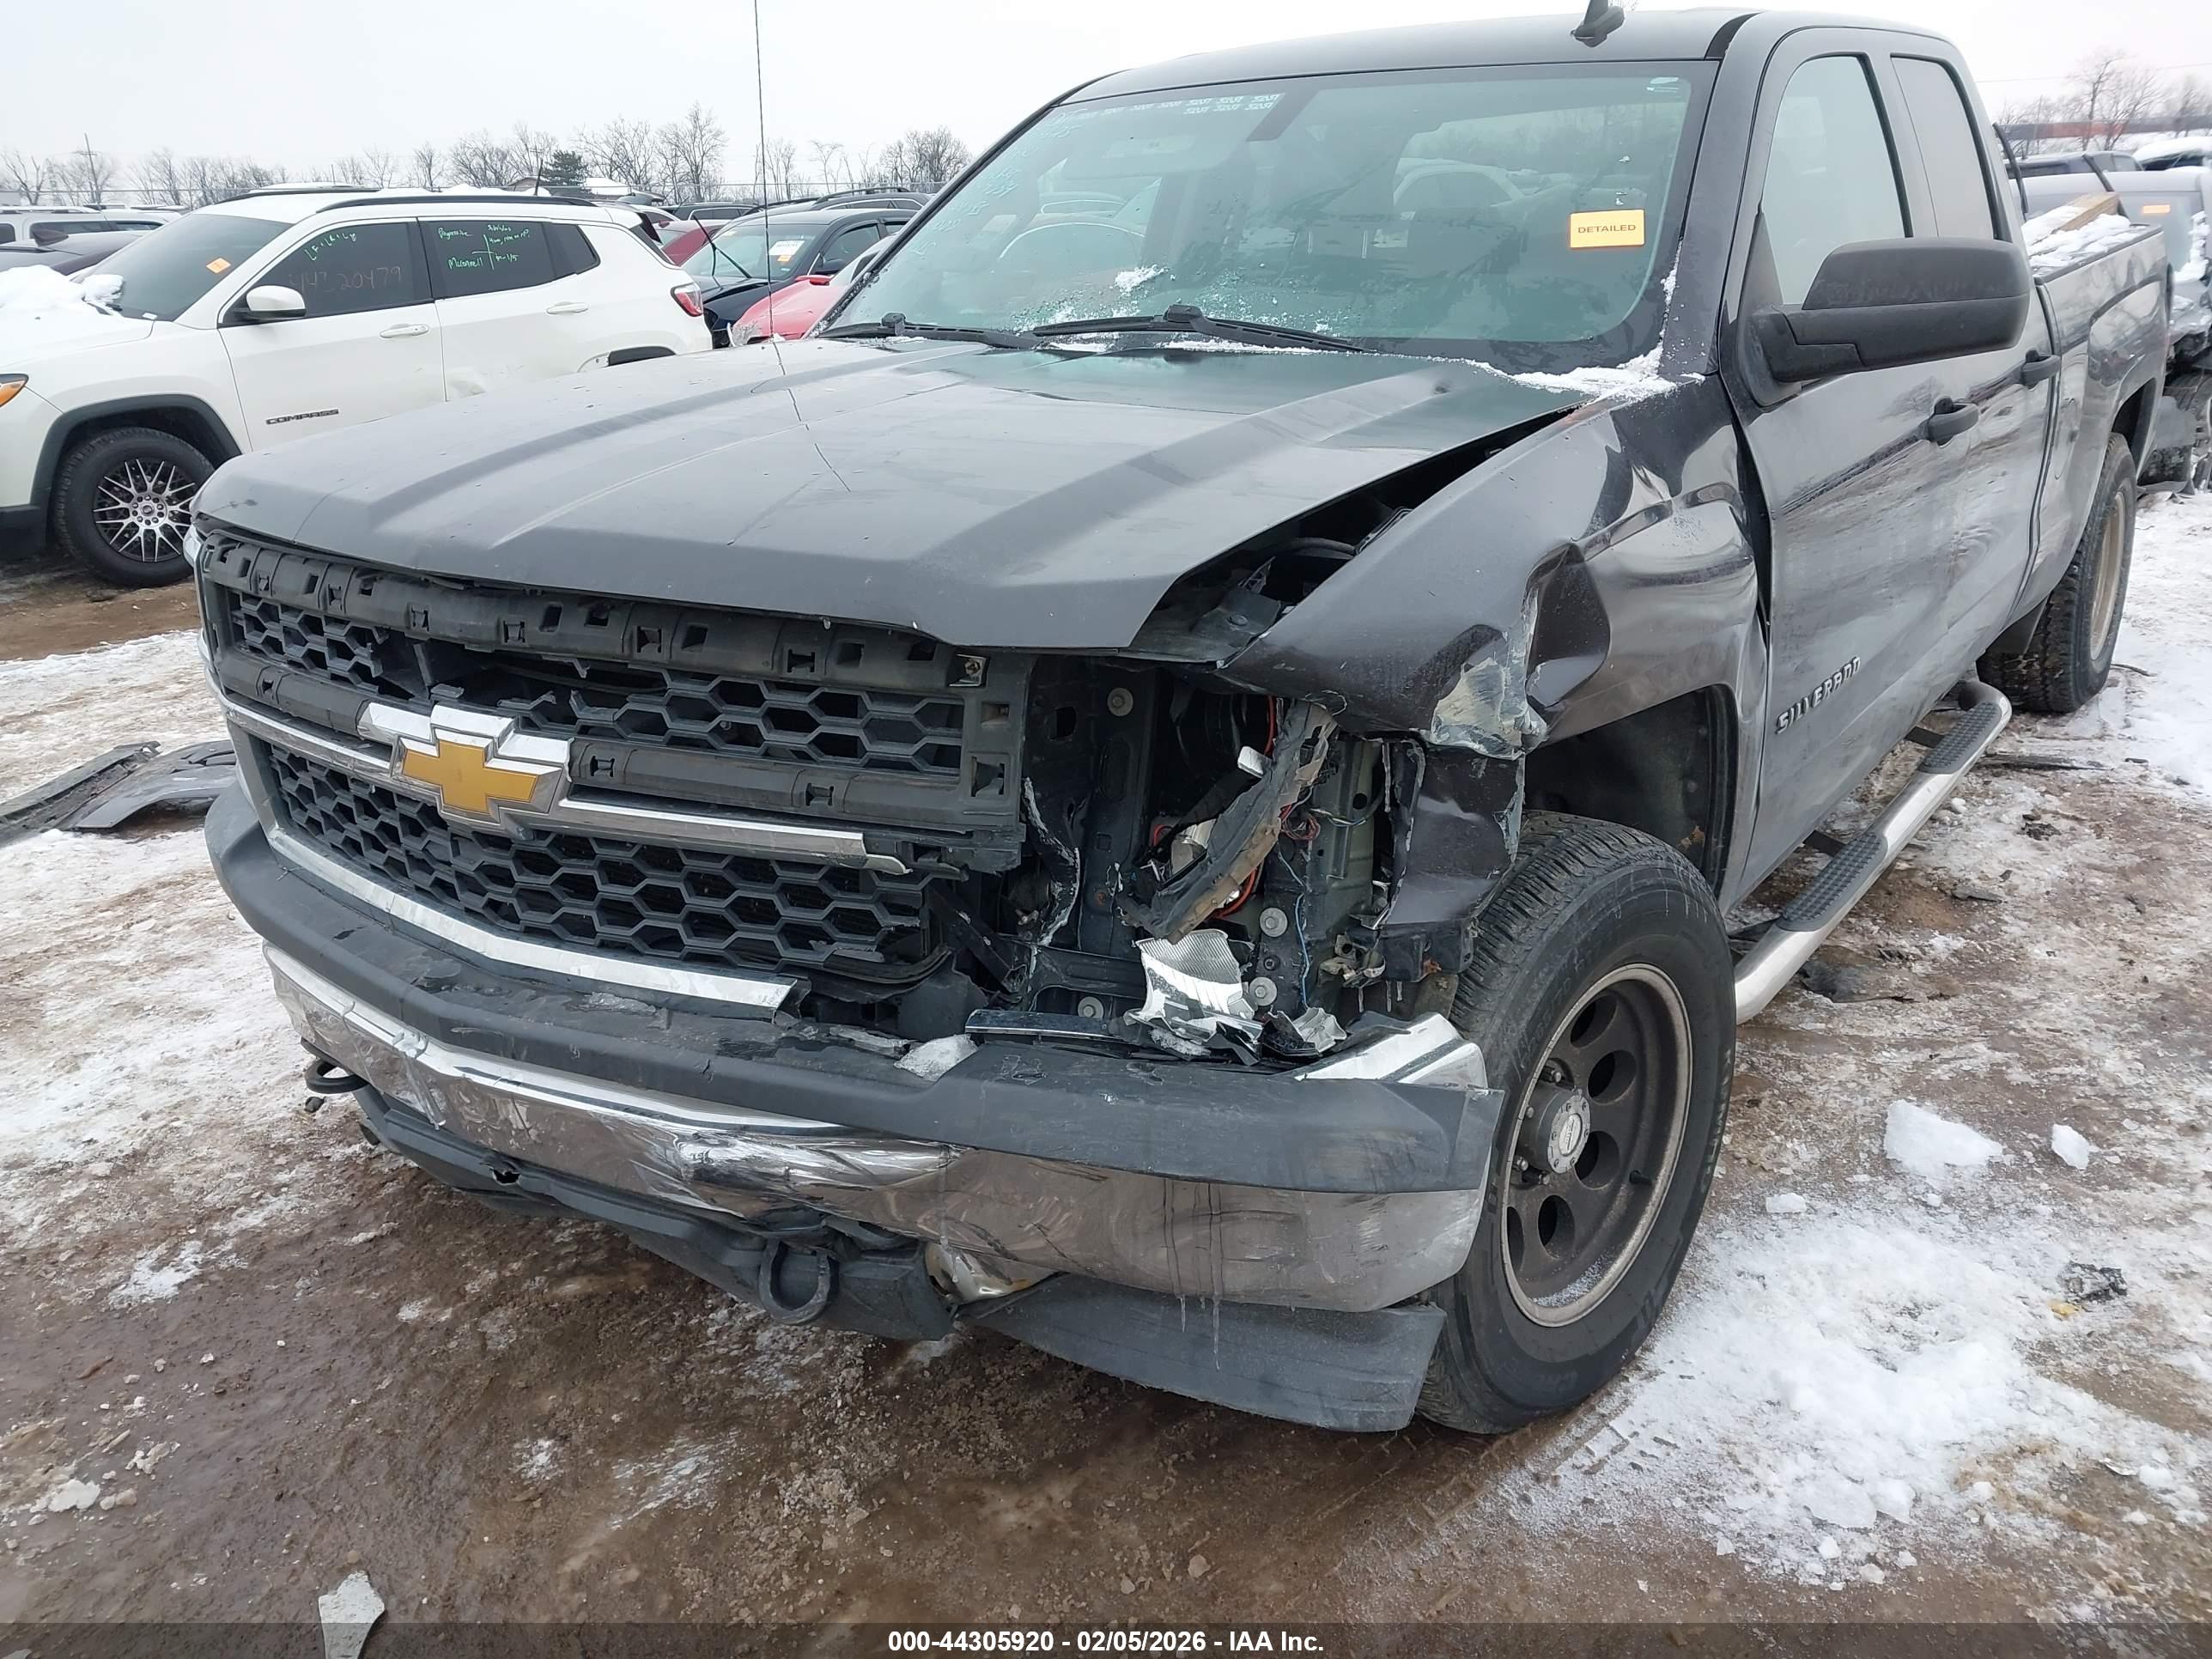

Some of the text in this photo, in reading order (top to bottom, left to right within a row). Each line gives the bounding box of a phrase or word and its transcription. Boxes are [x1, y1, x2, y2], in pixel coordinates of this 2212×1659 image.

[1577, 224, 1637, 234] DETAILED
[266, 408, 340, 425] COMPASS
[1775, 655, 1862, 735] SILVERADO
